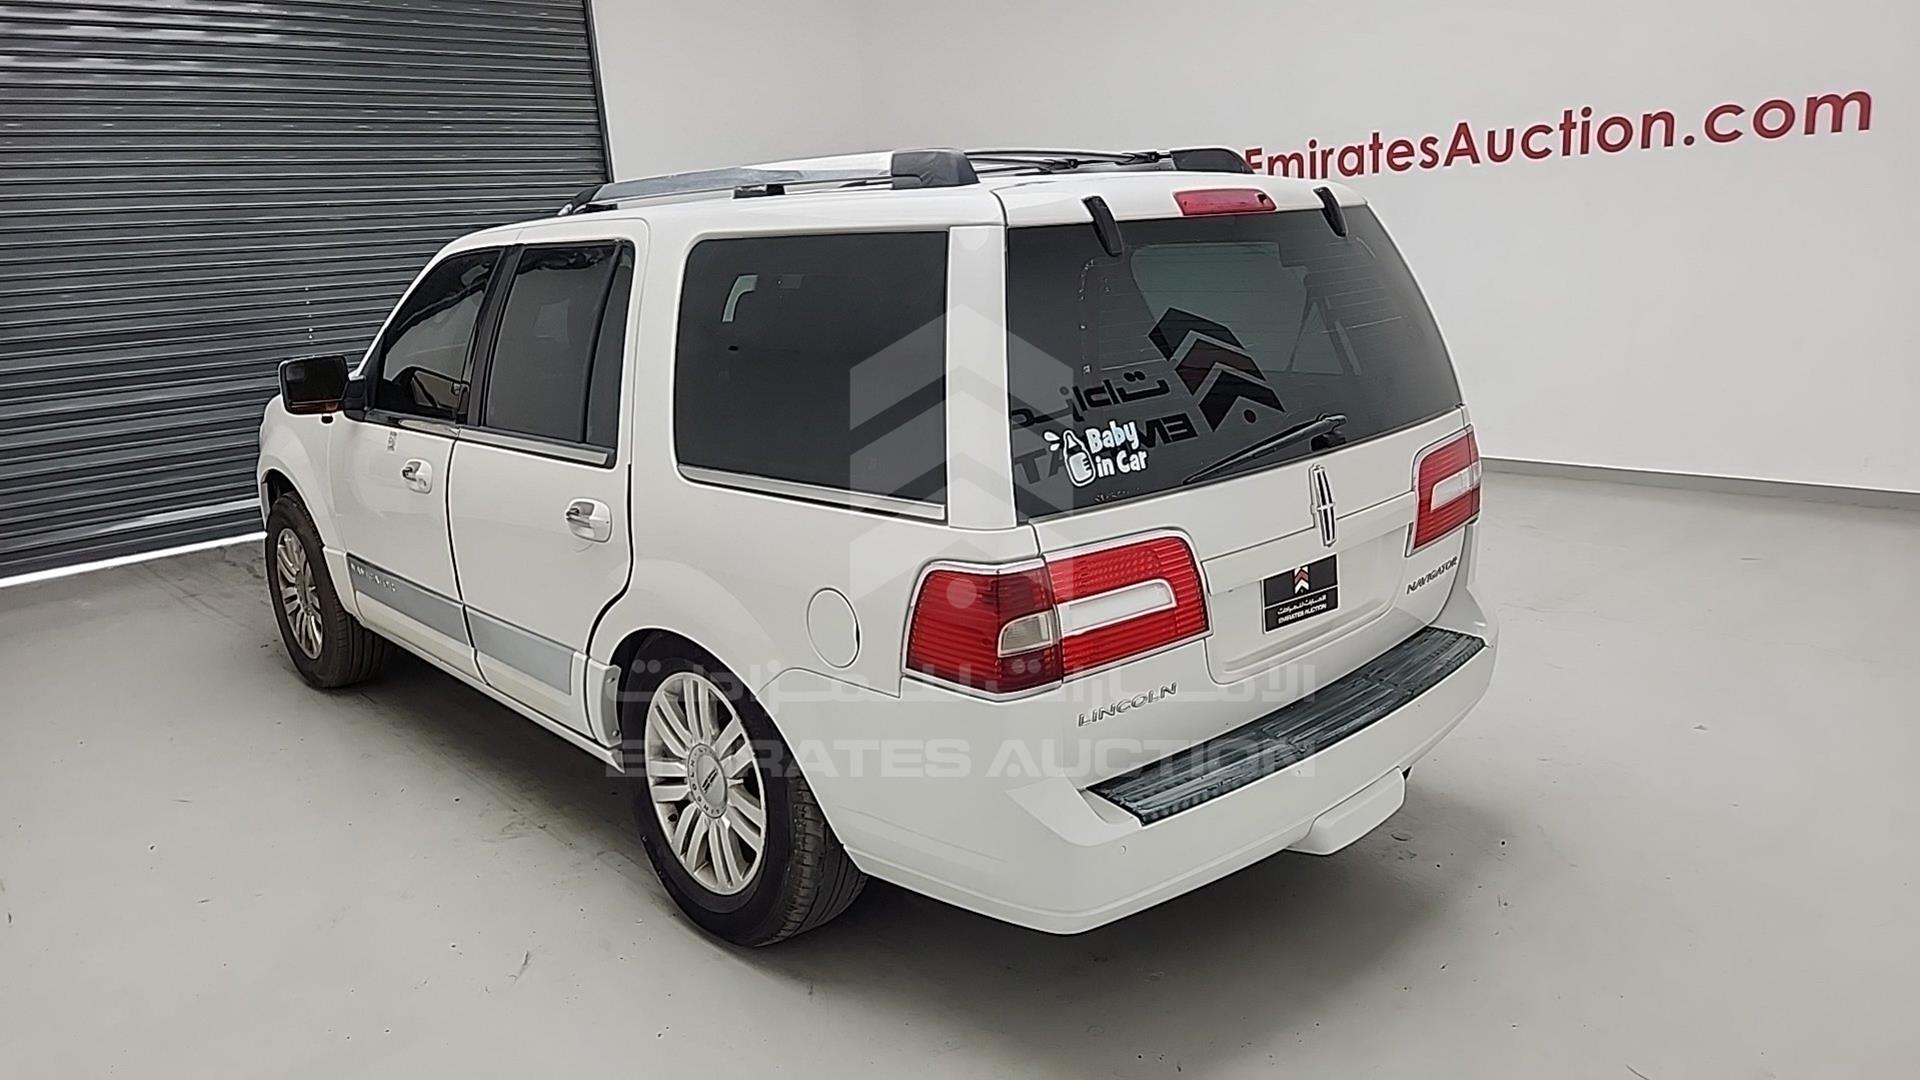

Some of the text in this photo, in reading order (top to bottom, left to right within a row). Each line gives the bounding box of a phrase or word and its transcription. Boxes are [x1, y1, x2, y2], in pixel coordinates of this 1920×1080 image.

[1245, 90, 1872, 180] EmiratesAuction.com
[1085, 420, 1139, 454] Baby
[1095, 449, 1148, 478] in Car
[1406, 556, 1458, 595] NAVIGATOR
[1278, 603, 1327, 624] EMIRATES AUCTION
[1078, 682, 1177, 728] LINCOLN
